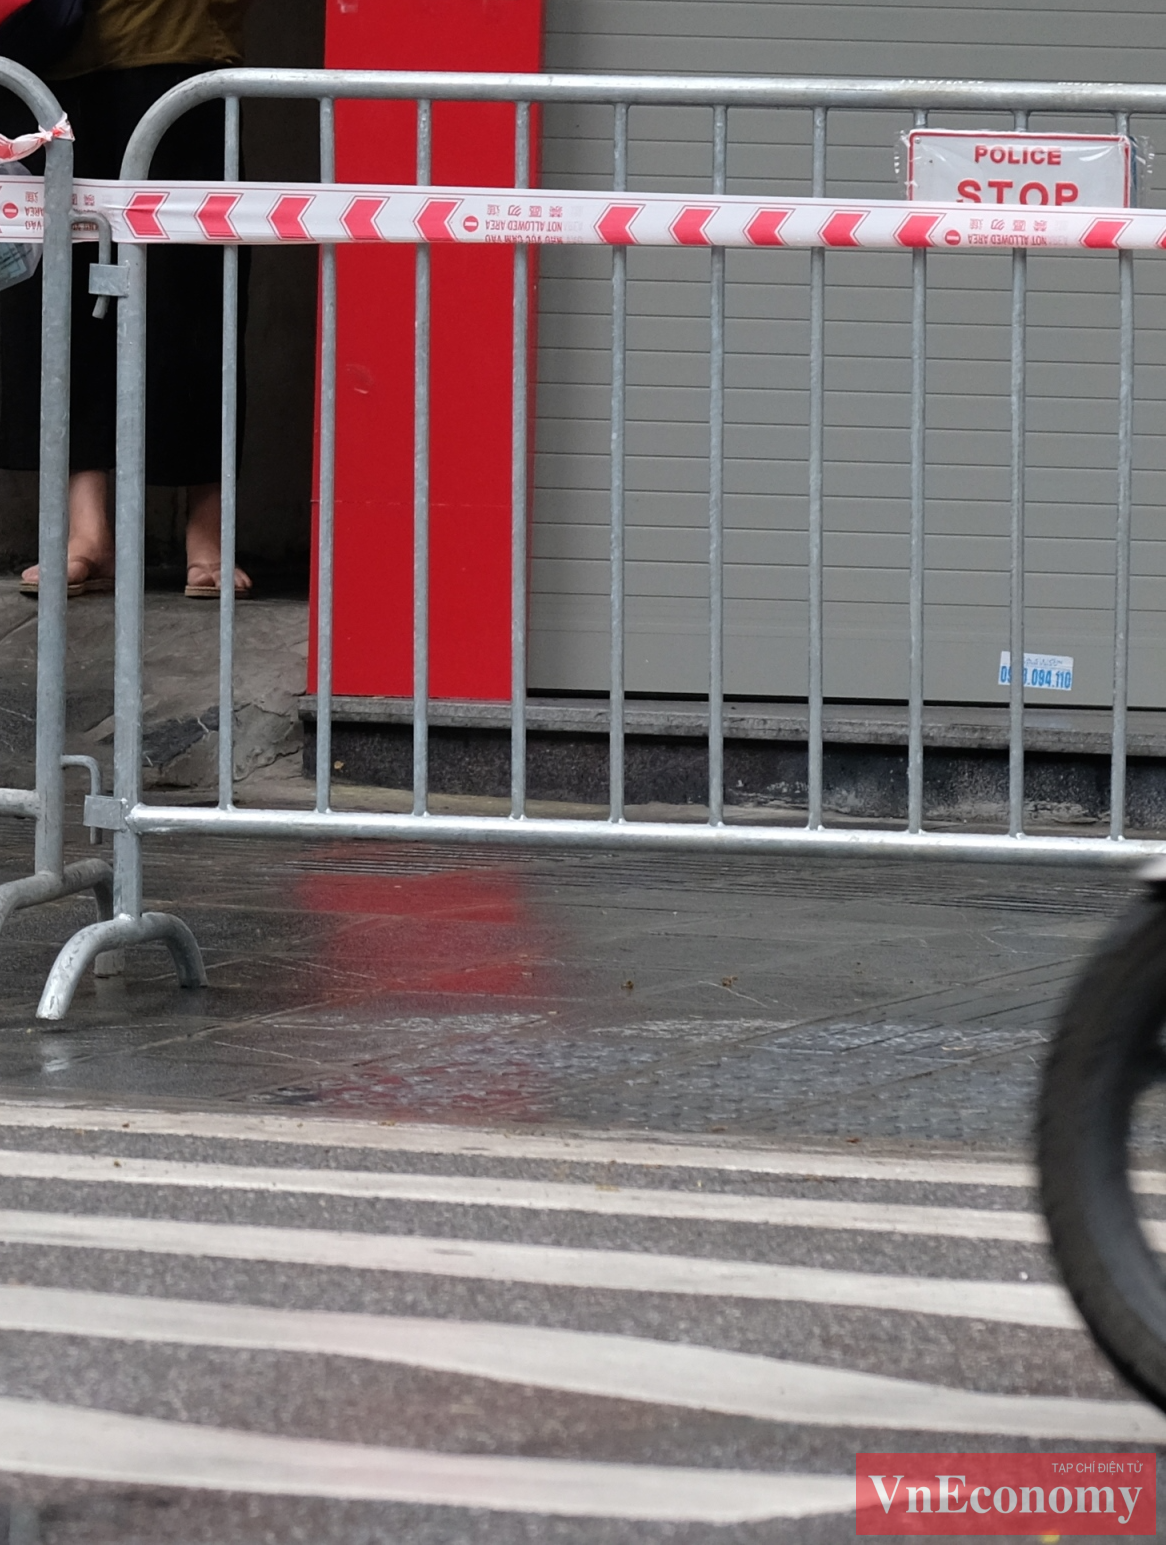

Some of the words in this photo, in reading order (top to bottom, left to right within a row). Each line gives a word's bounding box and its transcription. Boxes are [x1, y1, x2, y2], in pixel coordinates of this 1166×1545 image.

[975, 144, 1062, 166] POLICE
[957, 179, 1079, 205] STOP
[485, 220, 505, 230] AREA
[508, 221, 545, 232] ALLOWED
[546, 221, 562, 232] NOT
[968, 234, 988, 244] AREA
[991, 234, 1029, 245] ALLOWED
[1031, 235, 1047, 246] NOT
[1000, 665, 1072, 689] 0.094.110
